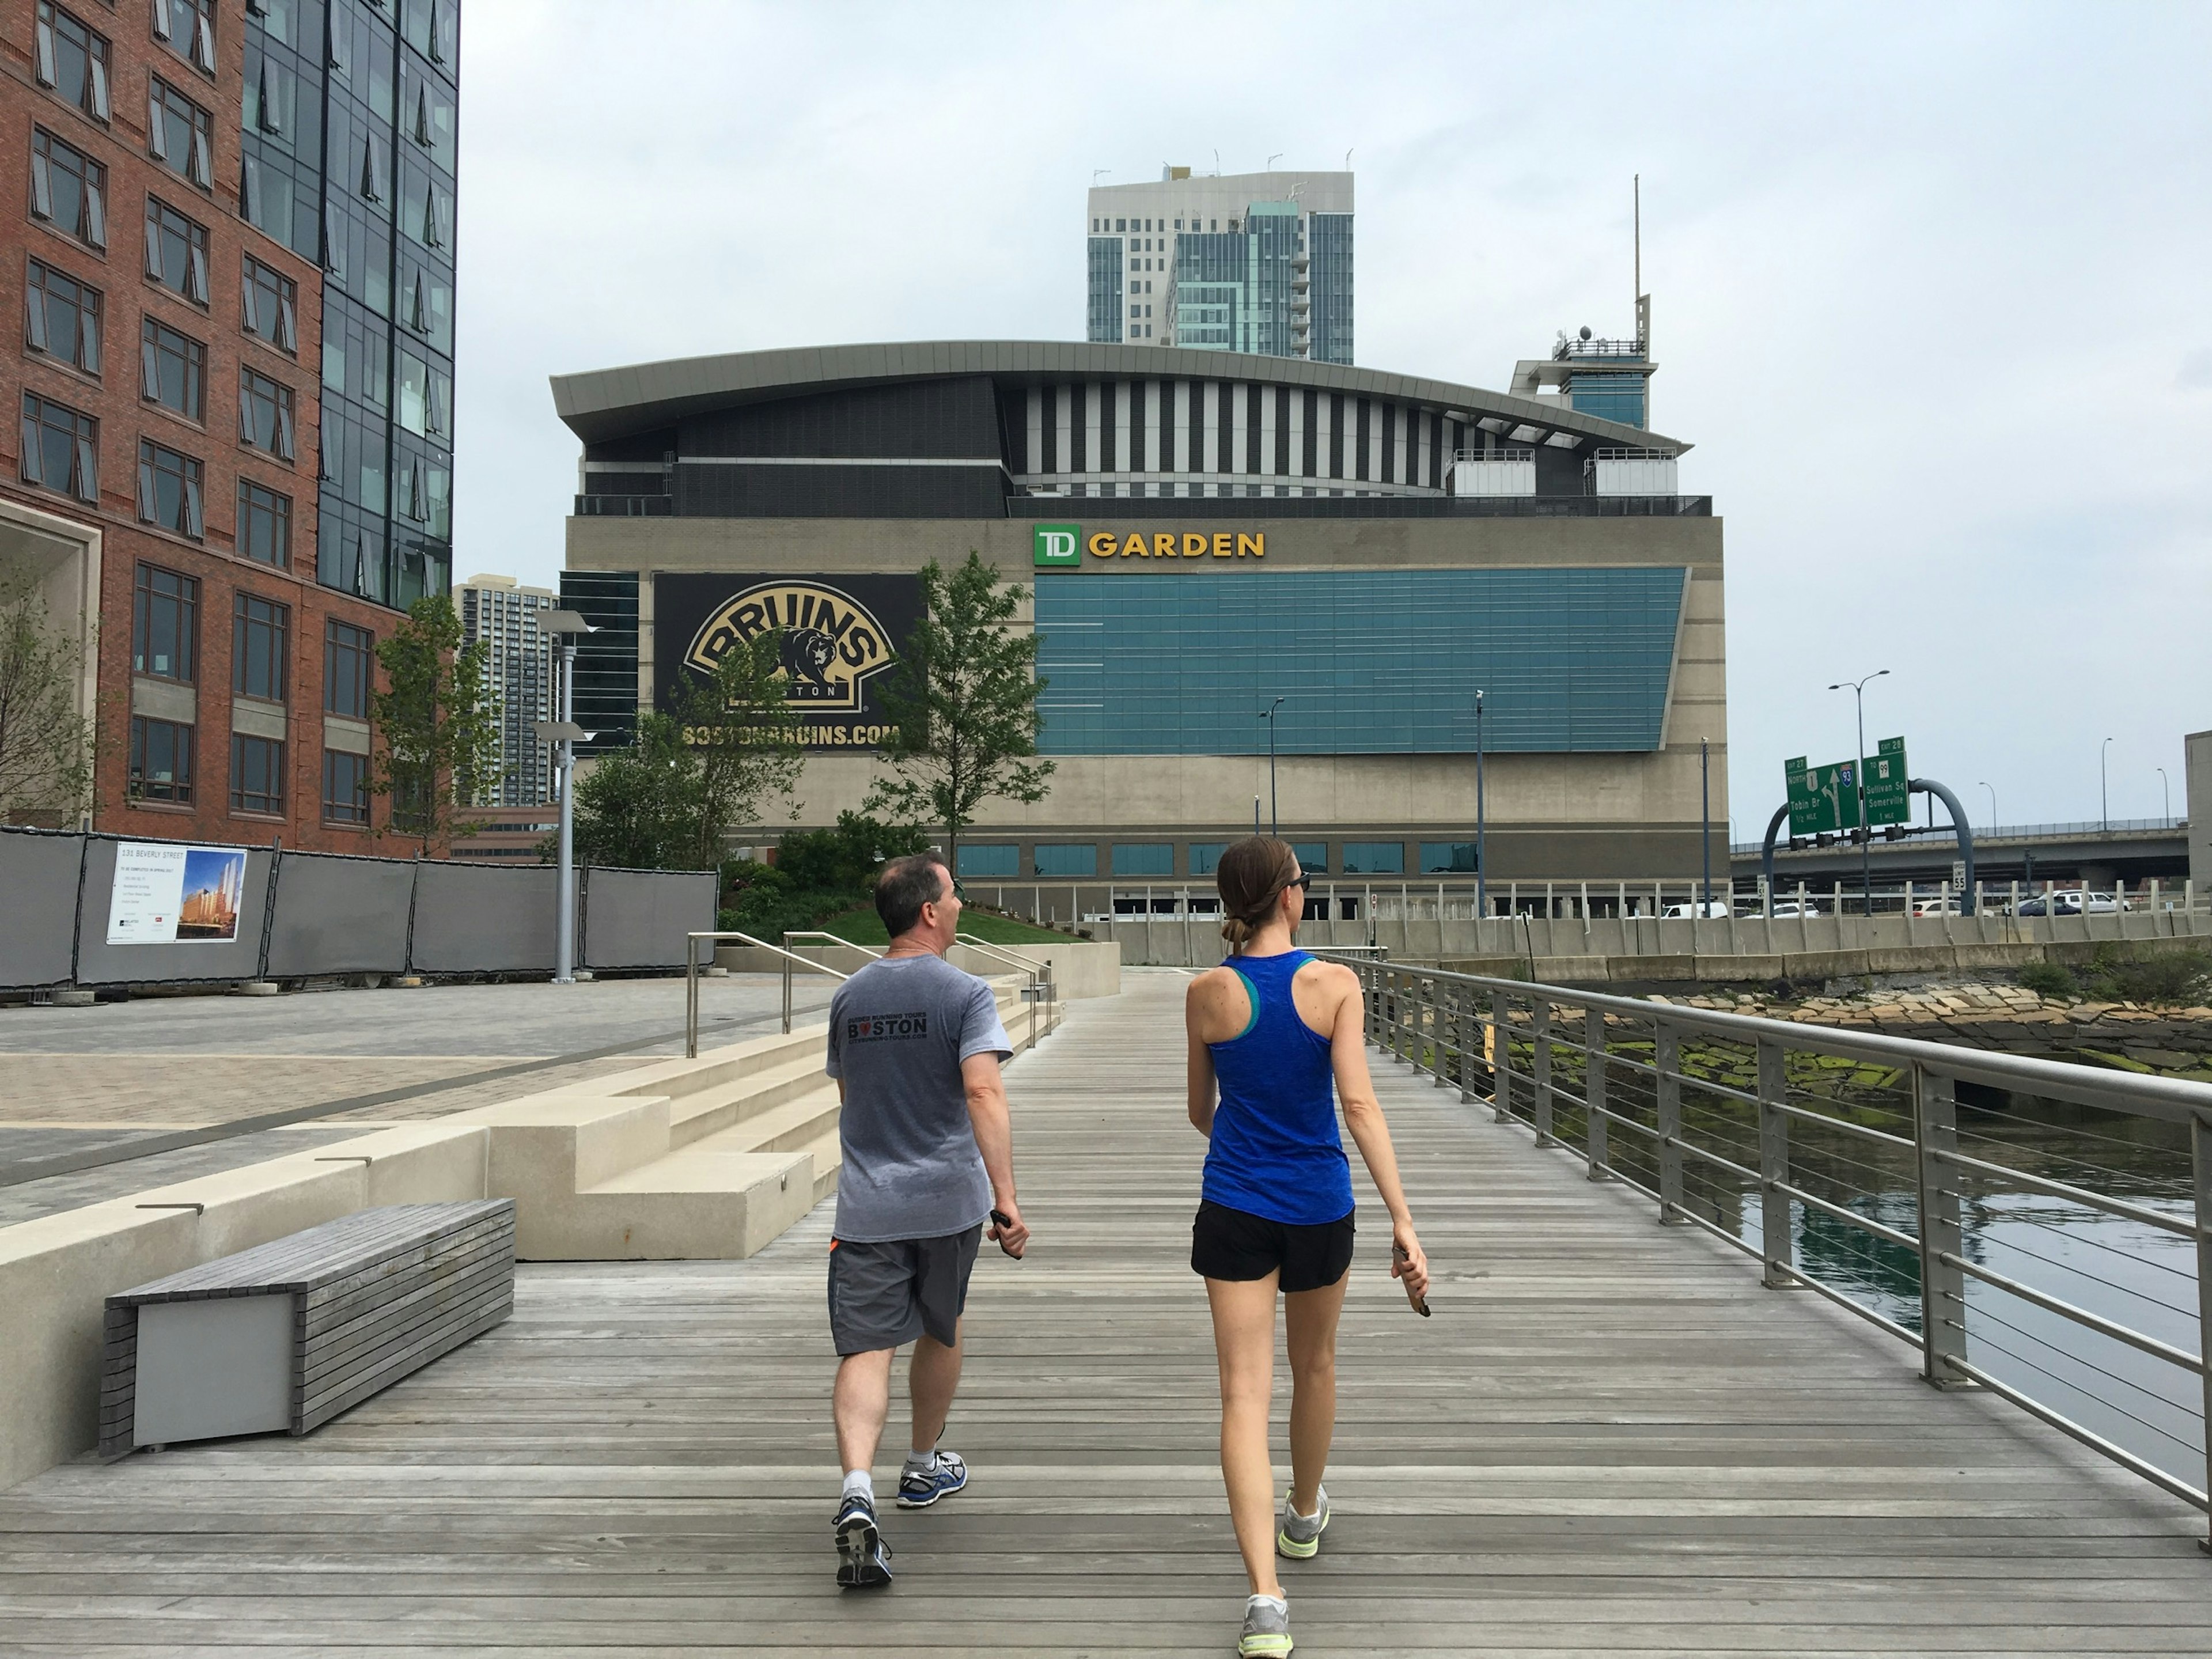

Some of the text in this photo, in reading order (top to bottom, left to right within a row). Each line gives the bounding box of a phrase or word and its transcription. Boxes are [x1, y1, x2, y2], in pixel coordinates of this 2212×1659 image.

[1039, 532, 1265, 558] TD GARDEN
[700, 593, 878, 668] BRUINS
[1892, 740, 1901, 750] 28
[1796, 759, 1804, 768] 27
[1880, 764, 1888, 774] 99
[1787, 775, 1806, 785] NORTH
[1843, 771, 1851, 782] 93
[1866, 781, 1904, 794] Sullivan Sq
[1790, 797, 1820, 811] Tobin Br
[1869, 795, 1903, 808] Somerville
[1806, 813, 1817, 821] MILE
[1955, 877, 1964, 888] 55
[849, 1033, 927, 1044] CITYRUNNINGTOURS.COM
